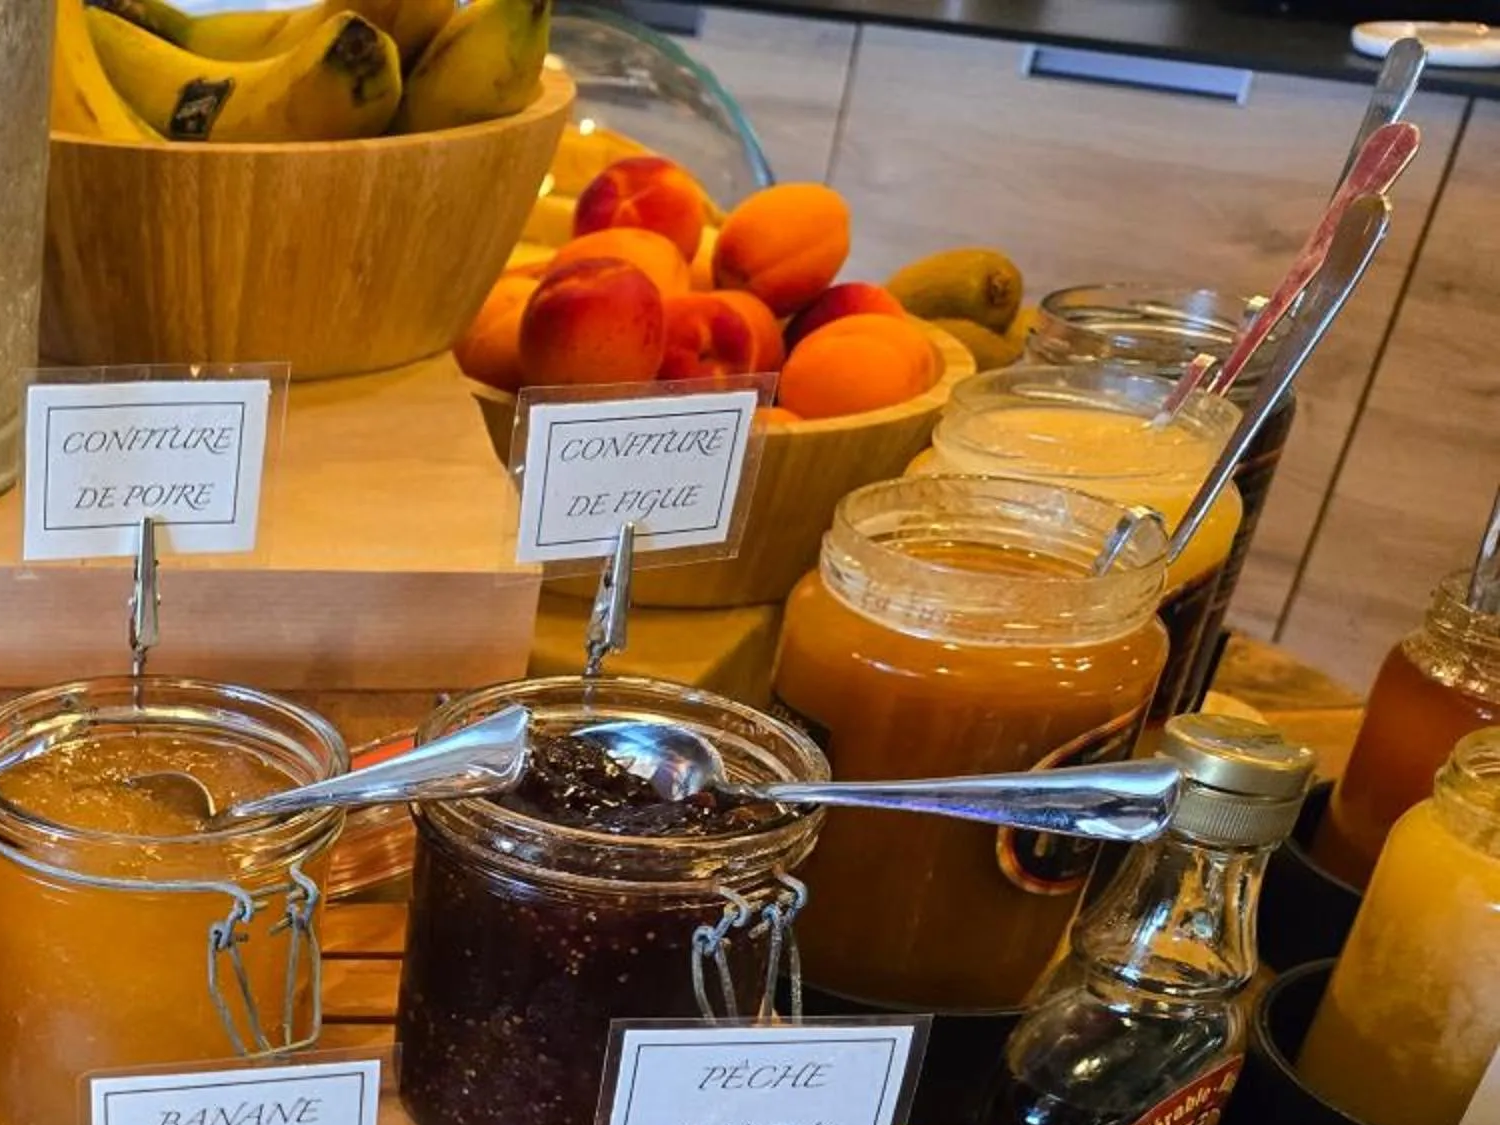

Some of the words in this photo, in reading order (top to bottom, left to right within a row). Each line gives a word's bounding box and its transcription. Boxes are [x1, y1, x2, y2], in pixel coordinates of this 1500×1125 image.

[62, 425, 234, 454] CONFITURE
[560, 427, 728, 462] CONFITURE
[74, 486, 117, 510] DE
[122, 483, 216, 511] POIRE
[566, 493, 610, 517] DE
[613, 485, 703, 520] FIGUE
